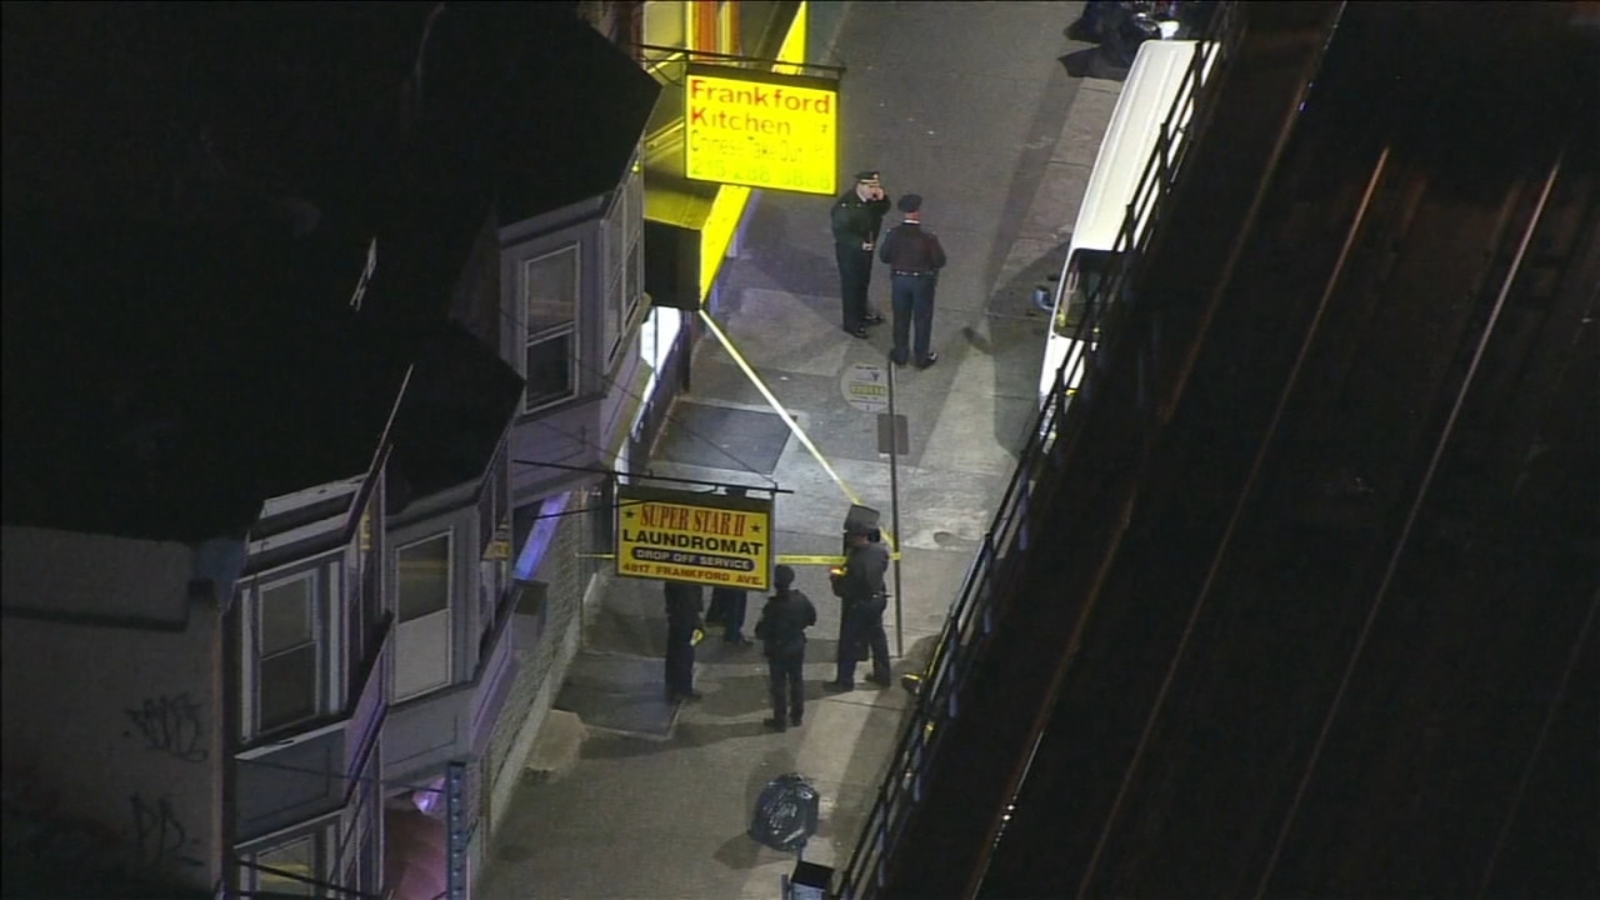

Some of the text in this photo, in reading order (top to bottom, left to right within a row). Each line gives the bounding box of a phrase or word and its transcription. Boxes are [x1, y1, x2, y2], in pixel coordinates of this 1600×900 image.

[691, 79, 831, 115] Frankford
[691, 105, 791, 136] Kitchen
[640, 503, 748, 537] SUPER STAR II
[623, 529, 764, 556] LAUNDROMAT
[636, 548, 750, 570] DROP OFF SERVICE
[655, 566, 731, 582] FRANKFORD
[736, 573, 764, 586] AVE.
